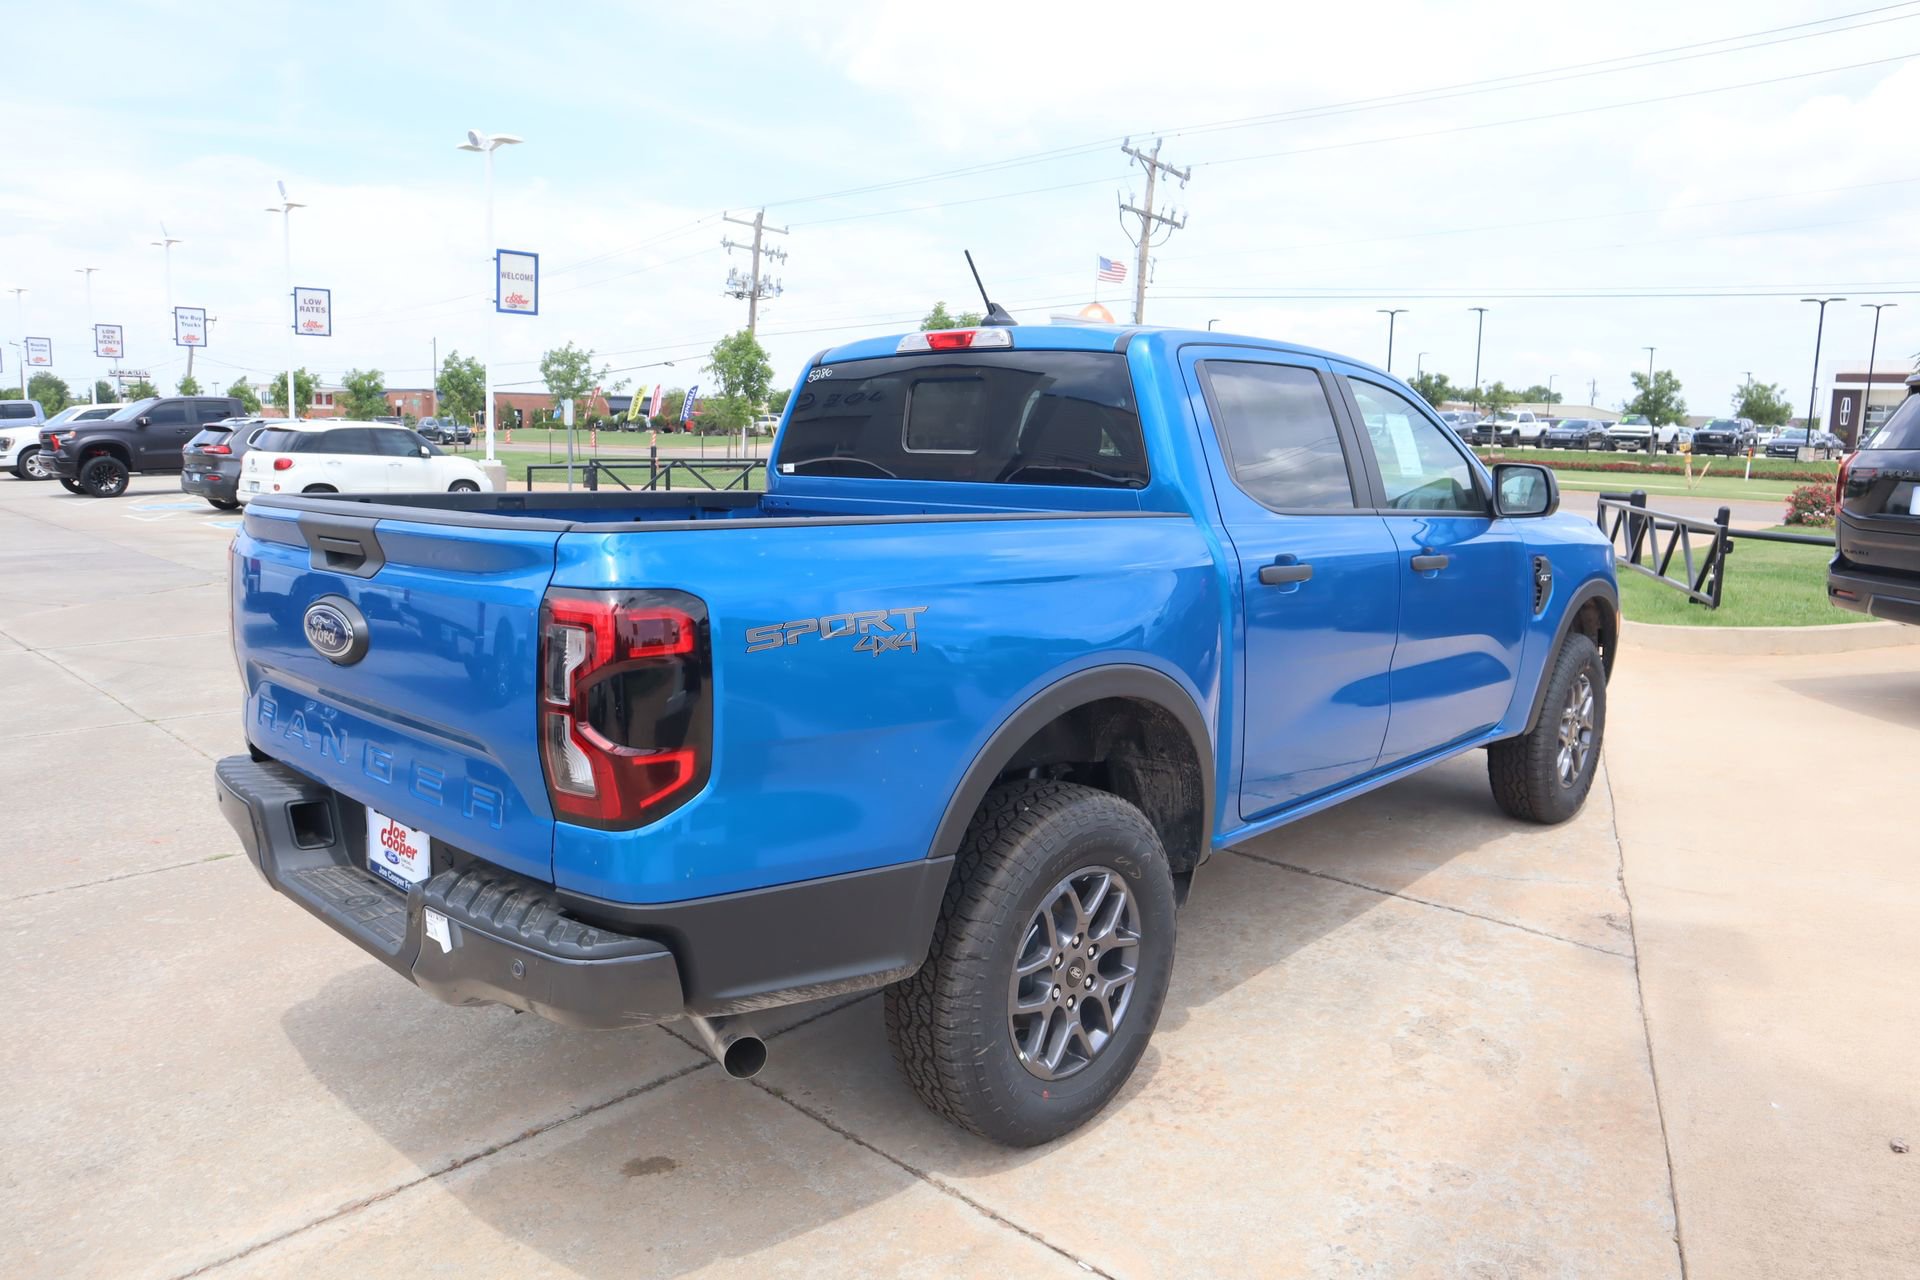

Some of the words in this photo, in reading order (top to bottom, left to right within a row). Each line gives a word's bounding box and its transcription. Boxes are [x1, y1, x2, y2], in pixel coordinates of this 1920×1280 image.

[501, 271, 534, 282] WELCOME
[190, 314, 202, 322] Buy
[299, 305, 326, 314] RATES
[808, 367, 833, 383] 5286
[683, 387, 698, 418] PINBALL
[310, 613, 338, 647] Ford
[745, 606, 928, 653] SPORT
[257, 694, 503, 830] RANGER
[388, 818, 407, 842] Joe
[381, 828, 418, 860] Cooper
